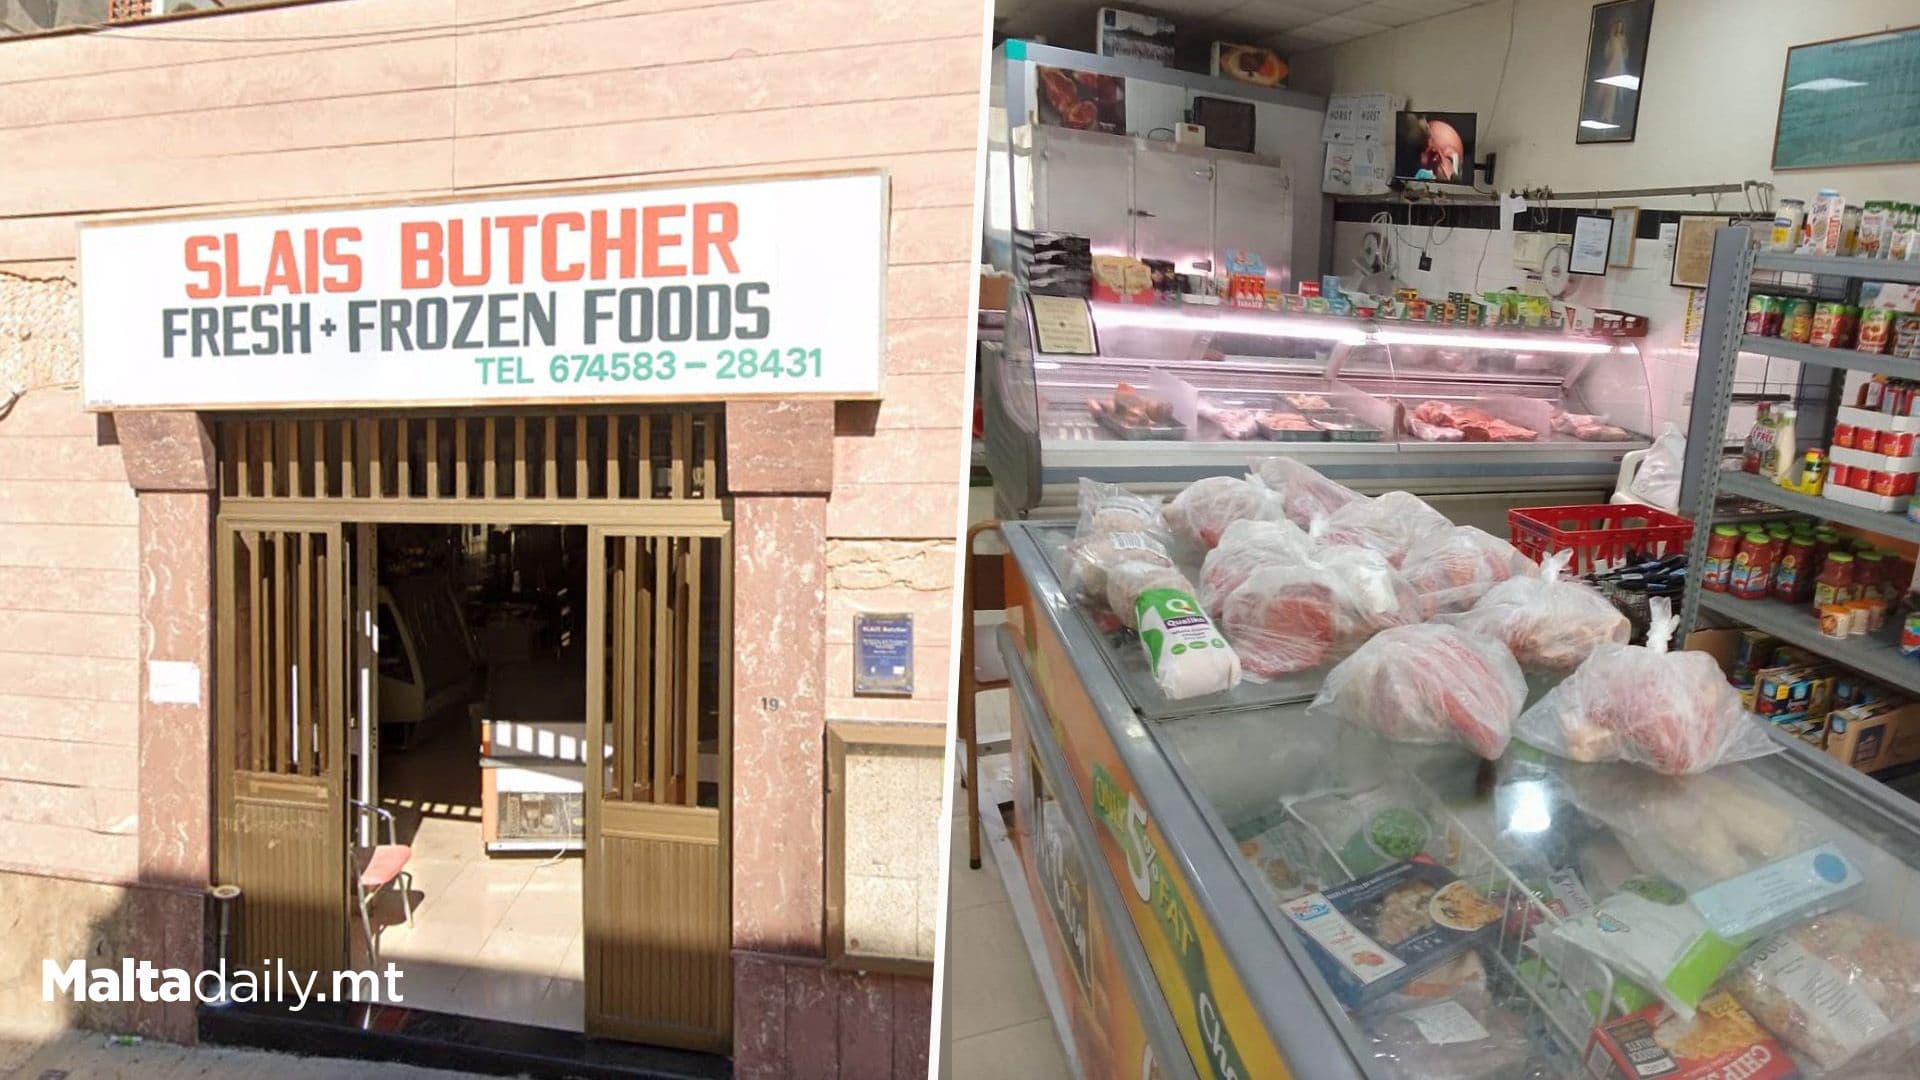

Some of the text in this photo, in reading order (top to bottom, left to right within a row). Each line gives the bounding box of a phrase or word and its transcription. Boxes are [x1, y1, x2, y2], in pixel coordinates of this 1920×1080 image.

[184, 200, 741, 299] SLAIS BUTCHER
[162, 301, 312, 358] FRESH
[348, 291, 557, 353] FROZEN
[583, 282, 770, 344] FOODS
[475, 356, 534, 386] TEL
[549, 350, 677, 384] 674583
[715, 347, 824, 380] 28431
[761, 696, 780, 712] 19
